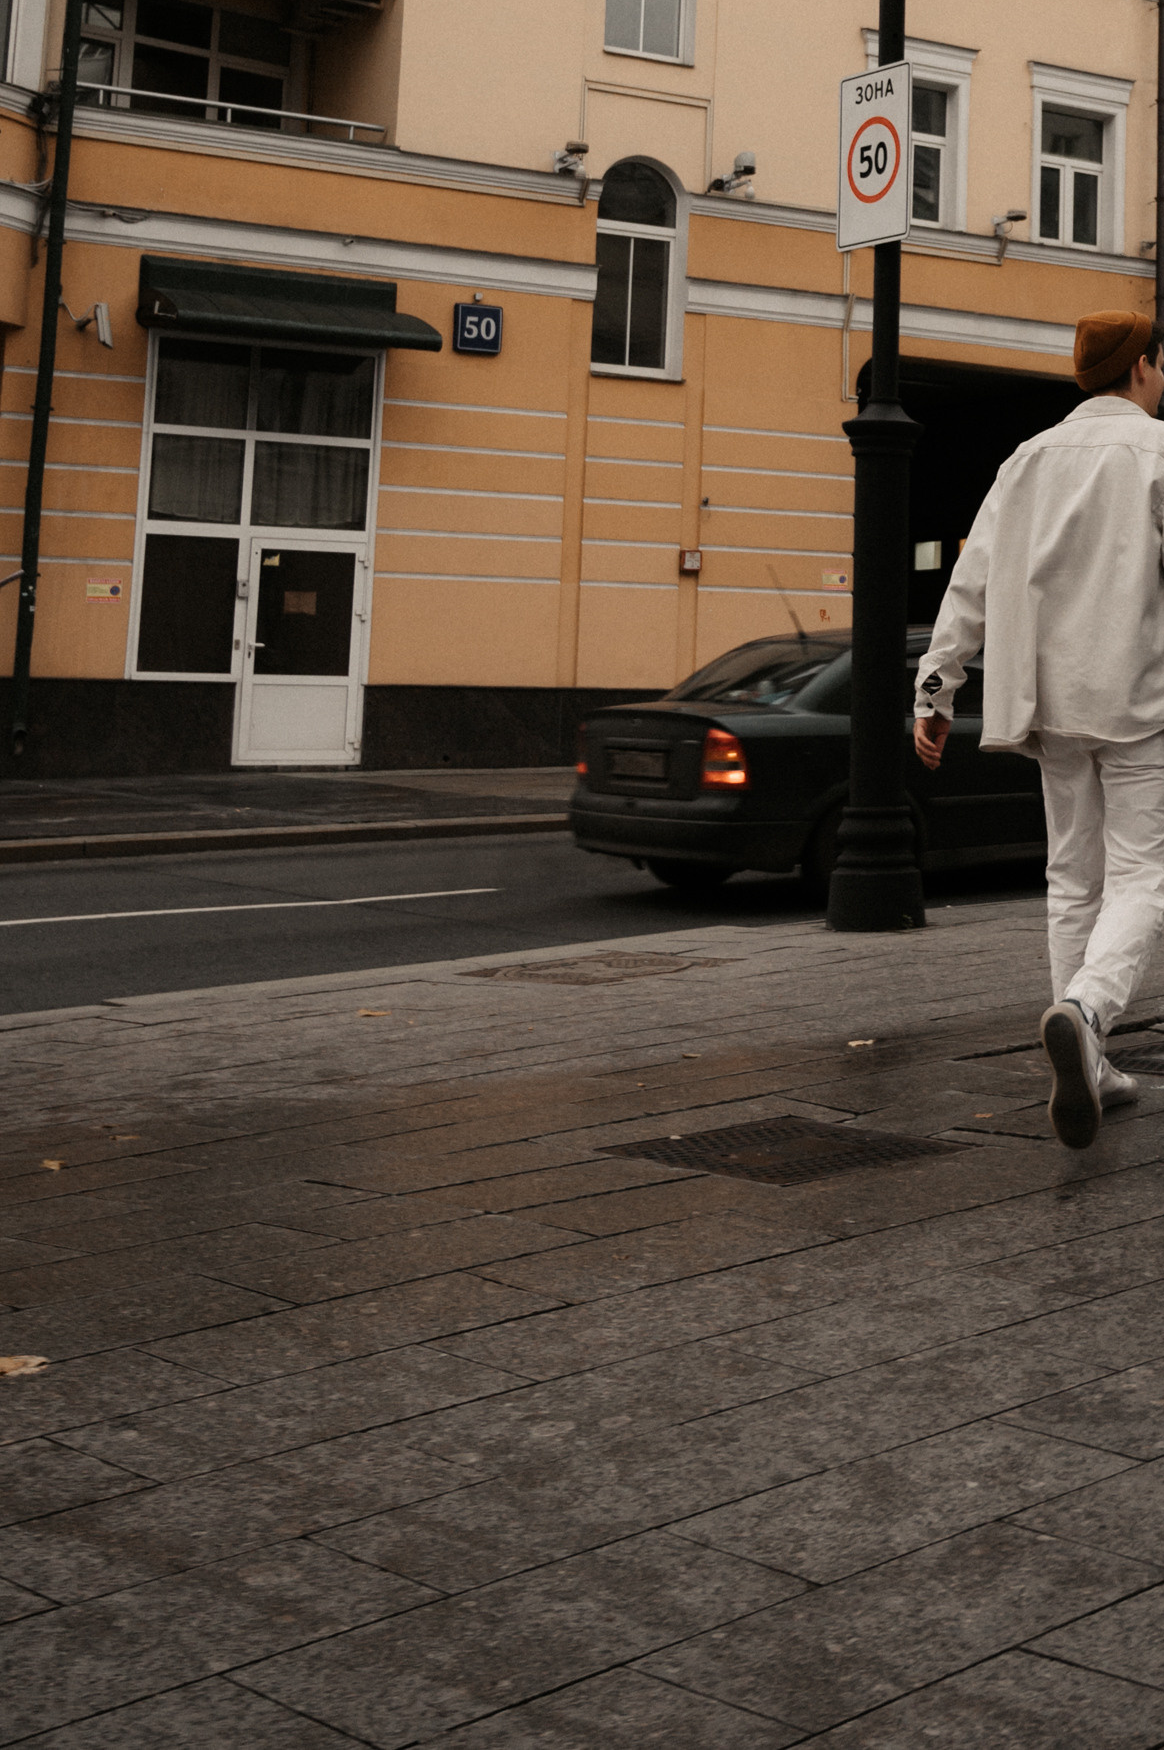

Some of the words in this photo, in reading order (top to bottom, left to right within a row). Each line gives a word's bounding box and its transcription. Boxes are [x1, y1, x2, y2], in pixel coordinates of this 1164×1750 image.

[855, 78, 894, 105] ЗОНА
[860, 141, 888, 179] 50
[464, 316, 497, 341] 50
